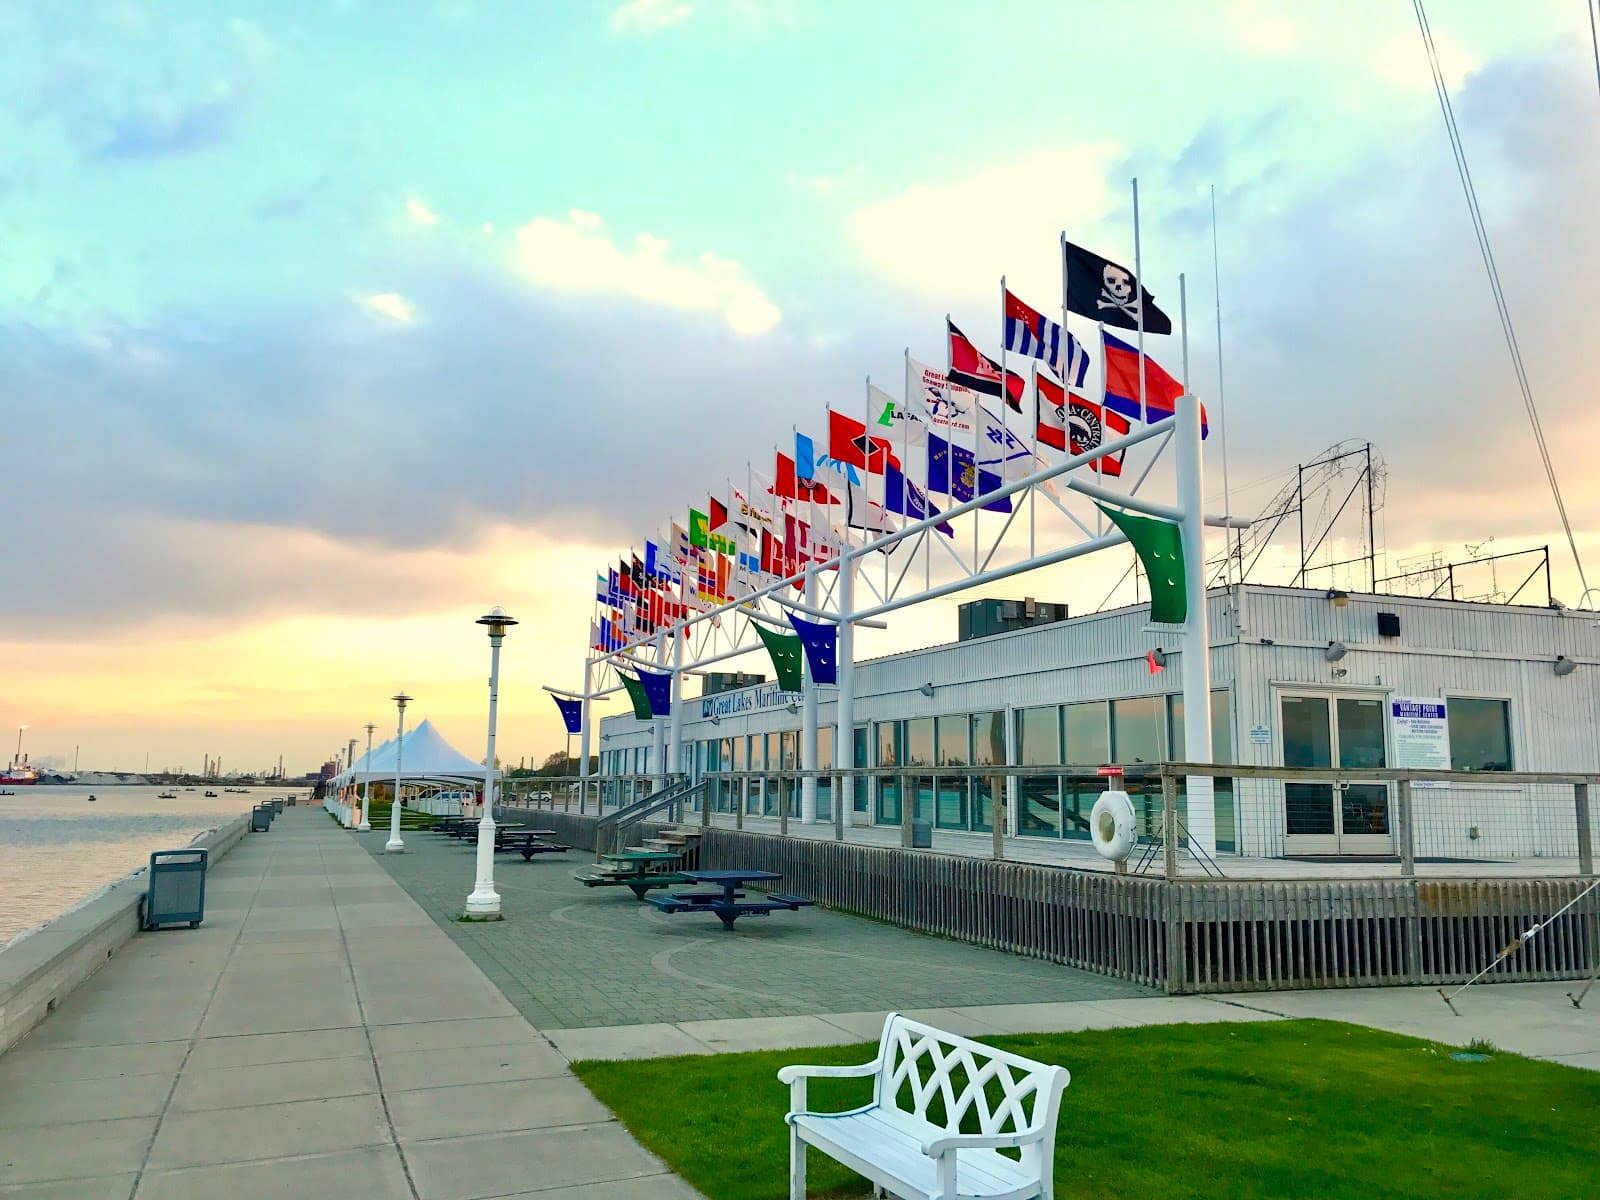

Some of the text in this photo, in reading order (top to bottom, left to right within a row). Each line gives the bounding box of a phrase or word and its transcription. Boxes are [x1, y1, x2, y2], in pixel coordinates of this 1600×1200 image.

[1080, 408, 1101, 447] CENTRAL
[713, 696, 732, 715] Great
[732, 691, 752, 713] Lakes
